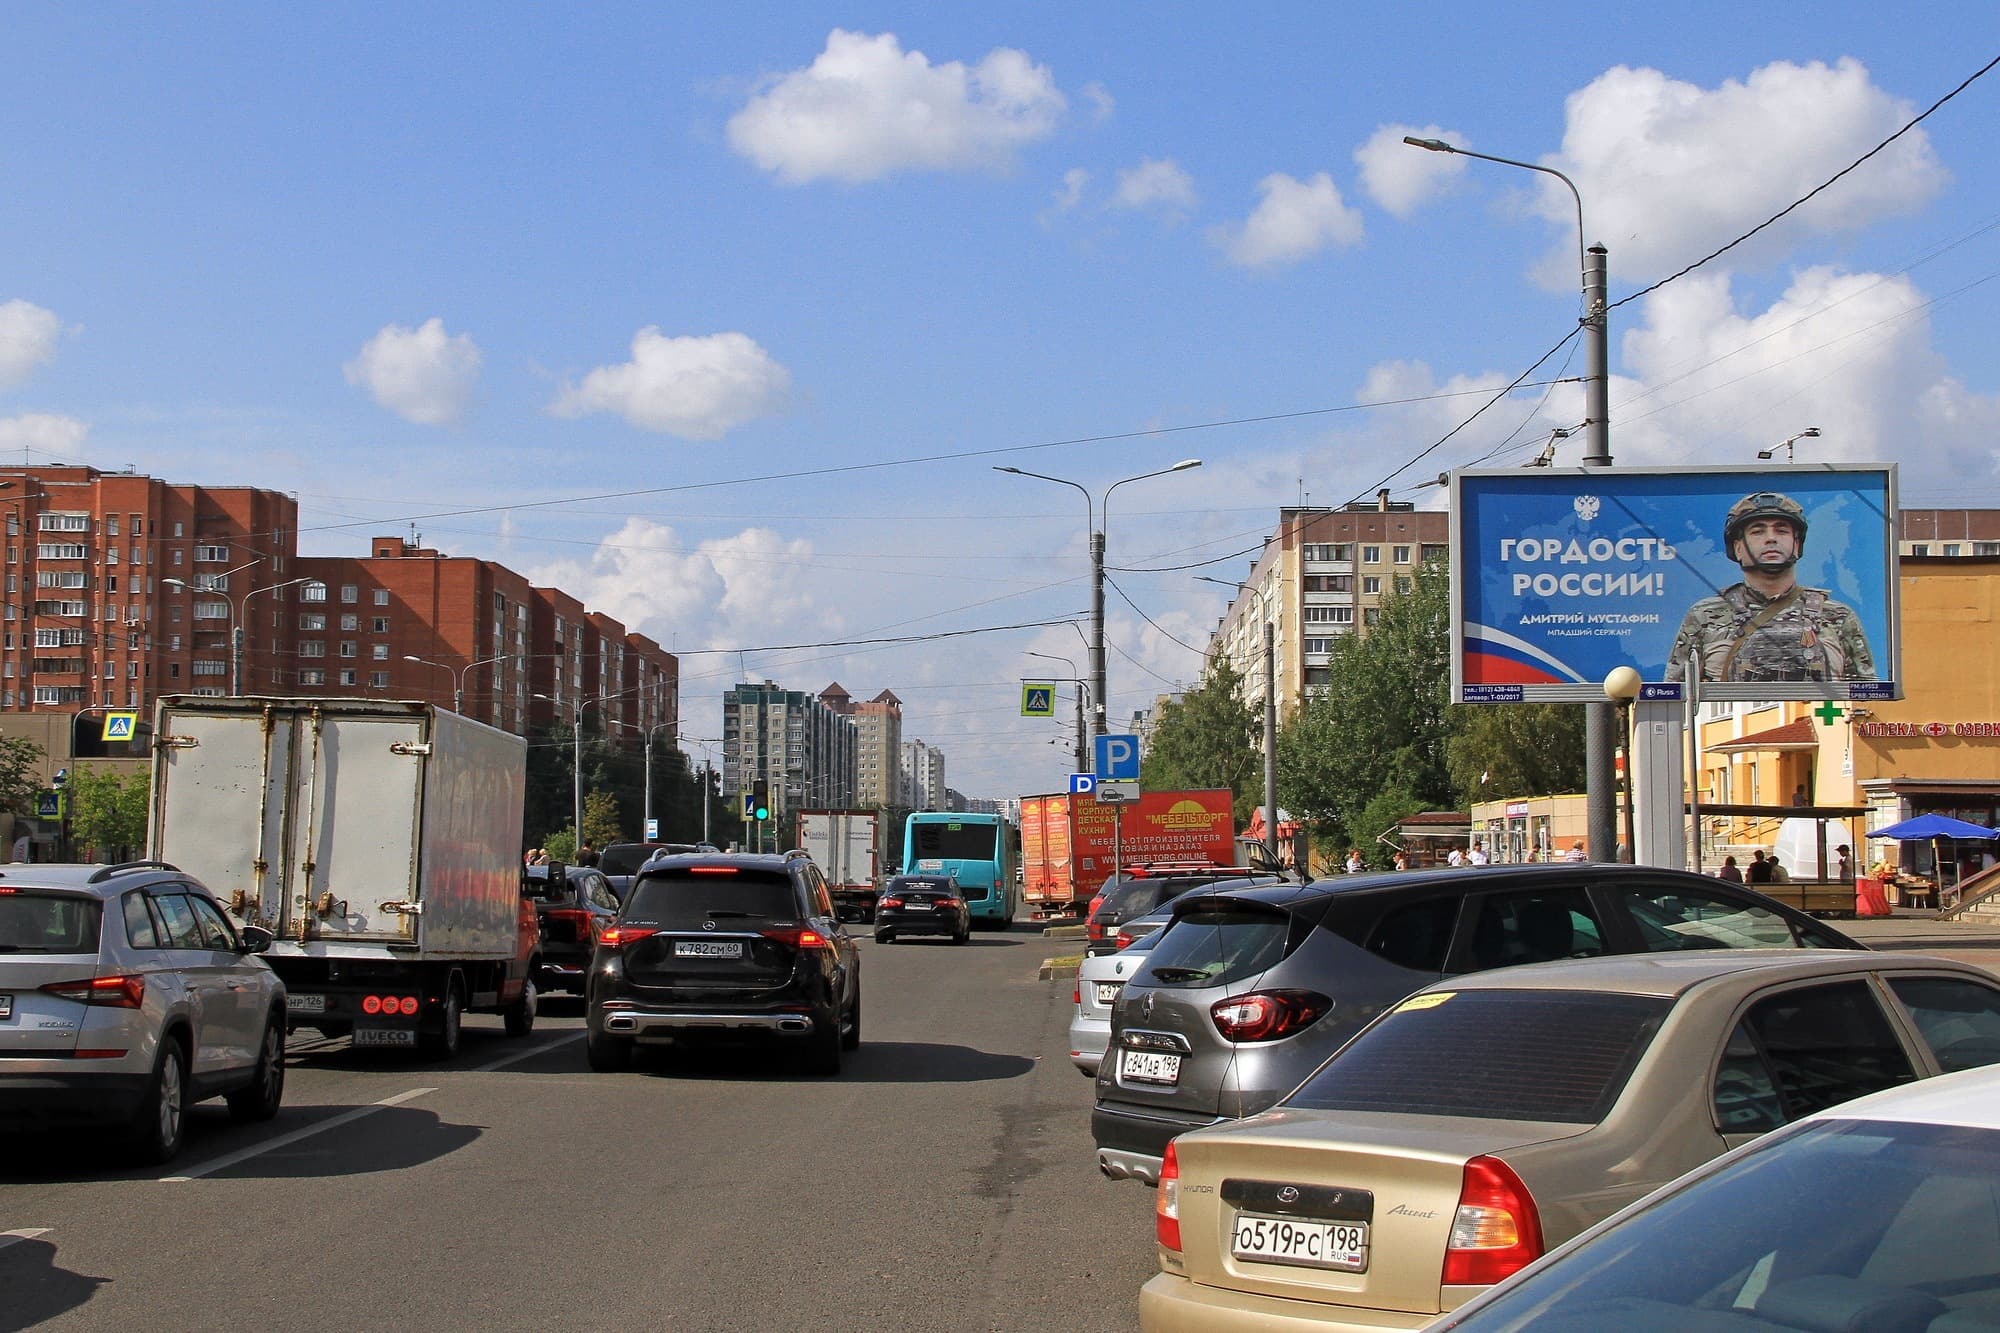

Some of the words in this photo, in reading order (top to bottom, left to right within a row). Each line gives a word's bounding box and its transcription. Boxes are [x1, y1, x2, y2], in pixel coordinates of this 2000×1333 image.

[1500, 537, 1676, 563] ГОРДОСТЬ
[1513, 573, 1664, 598] РОССИИ!
[1520, 611, 1584, 625] ДМИТРИЙ
[1588, 613, 1660, 624] МУСТАФИН
[1547, 627, 1593, 637] МЛАДШИЙ
[1594, 628, 1632, 637] СЕРЖАНТ
[1858, 722, 1917, 737] АПТЕКА
[1107, 740, 1132, 776] P
[1077, 798, 1097, 807] МЯГ
[1078, 826, 1106, 835] КУХНИ
[1090, 836, 1127, 846] МЕБЕЬ
[1143, 833, 1221, 844] ПРОИЗВОДИТЕЛЯ
[1160, 843, 1171, 851] НА
[1174, 842, 1202, 851] ЗАКАЗ
[679, 943, 725, 955] К782СМ
[727, 943, 739, 952] 60
[306, 996, 322, 1006] 126
[361, 1031, 409, 1041] IVECO
[1126, 1053, 1160, 1075] С841АВ
[1162, 1055, 1178, 1072] 198
[1385, 1203, 1440, 1219] Accent
[1240, 1220, 1320, 1256] О519РС
[1326, 1226, 1359, 1252] 198
[1330, 1250, 1348, 1261] RUS
